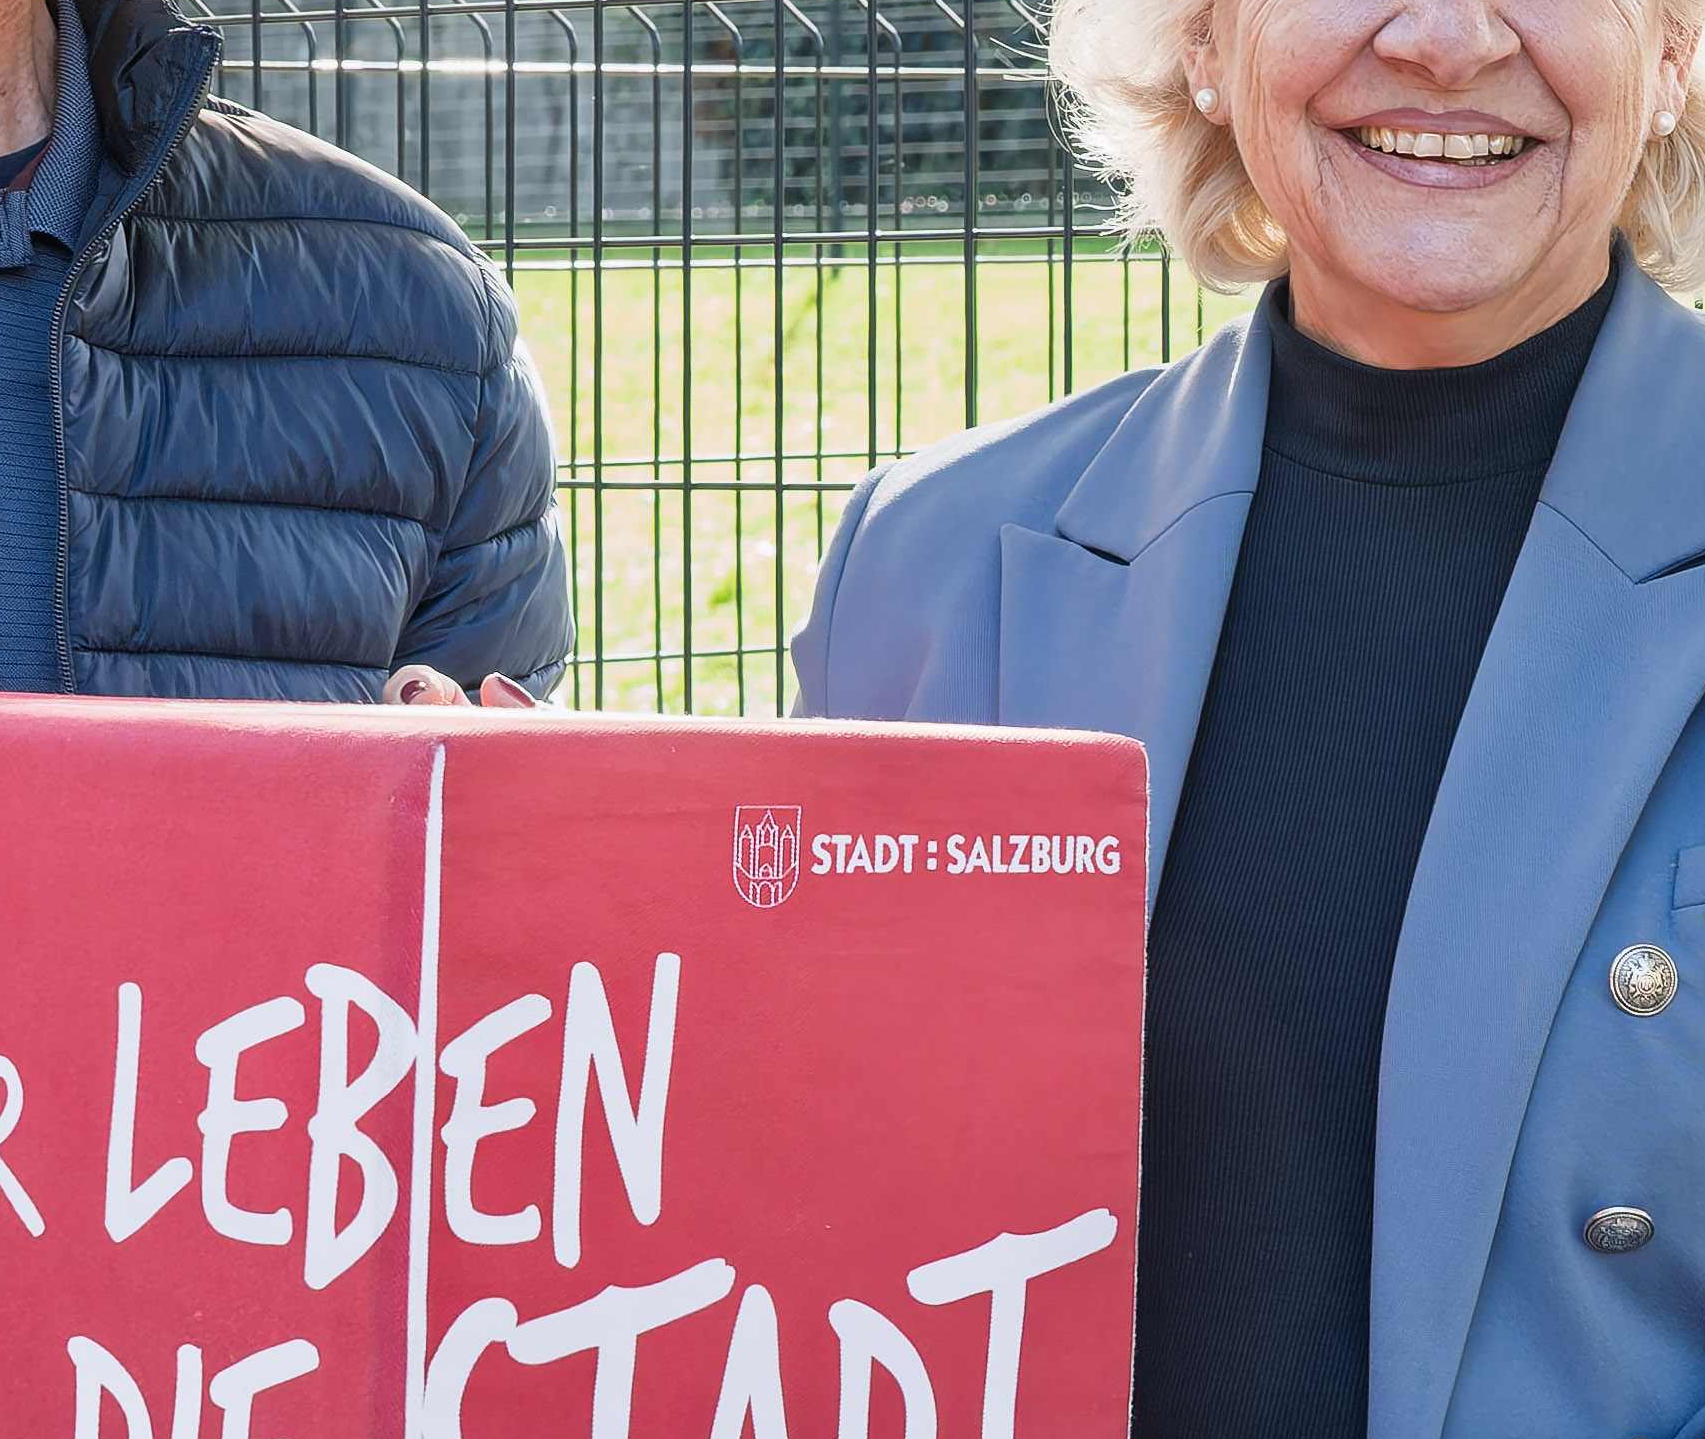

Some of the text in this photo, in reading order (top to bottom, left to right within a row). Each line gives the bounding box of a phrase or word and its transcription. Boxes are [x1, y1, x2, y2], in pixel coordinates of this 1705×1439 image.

[810, 833, 1121, 875] STADT SALZBURG
[103, 951, 682, 1291] LEBEN
